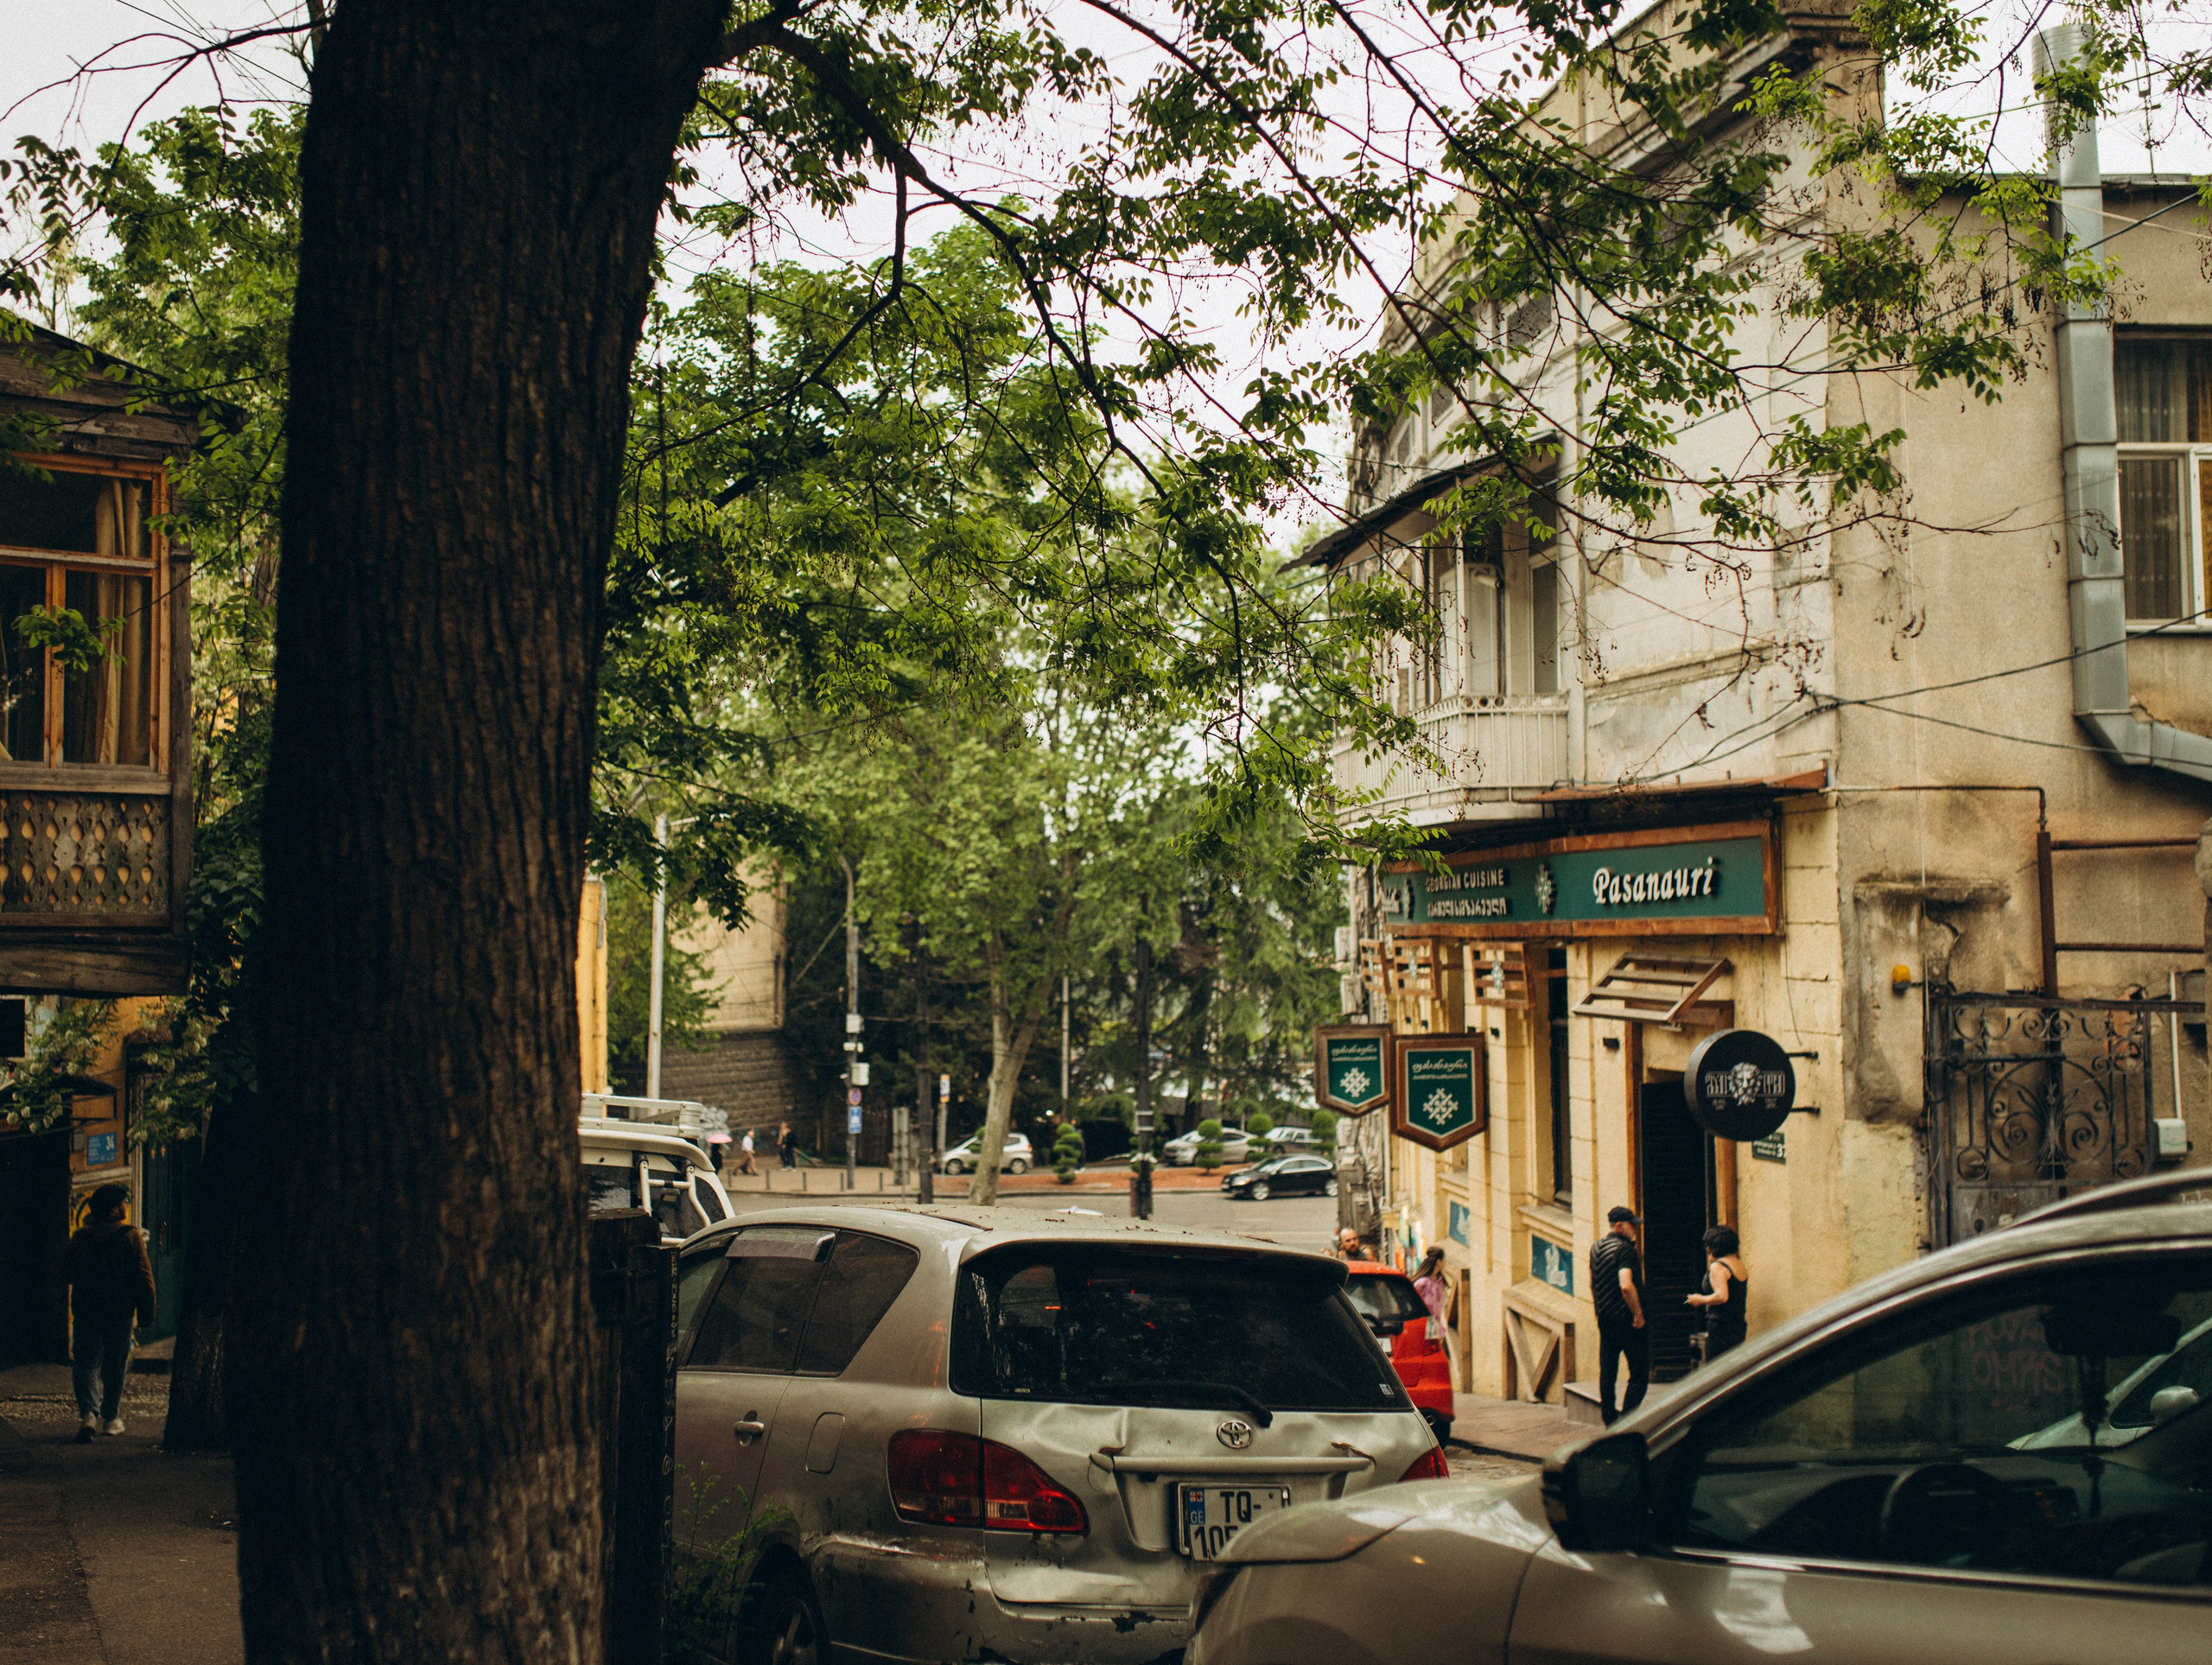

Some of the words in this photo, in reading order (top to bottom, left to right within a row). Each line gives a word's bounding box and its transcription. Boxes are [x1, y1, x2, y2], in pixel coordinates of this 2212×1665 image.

[1426, 874, 1461, 893] GEORGIAN
[1464, 867, 1504, 889] CUISINE
[1593, 856, 1713, 904] Pasanauri
[1190, 1511, 1204, 1524] GE
